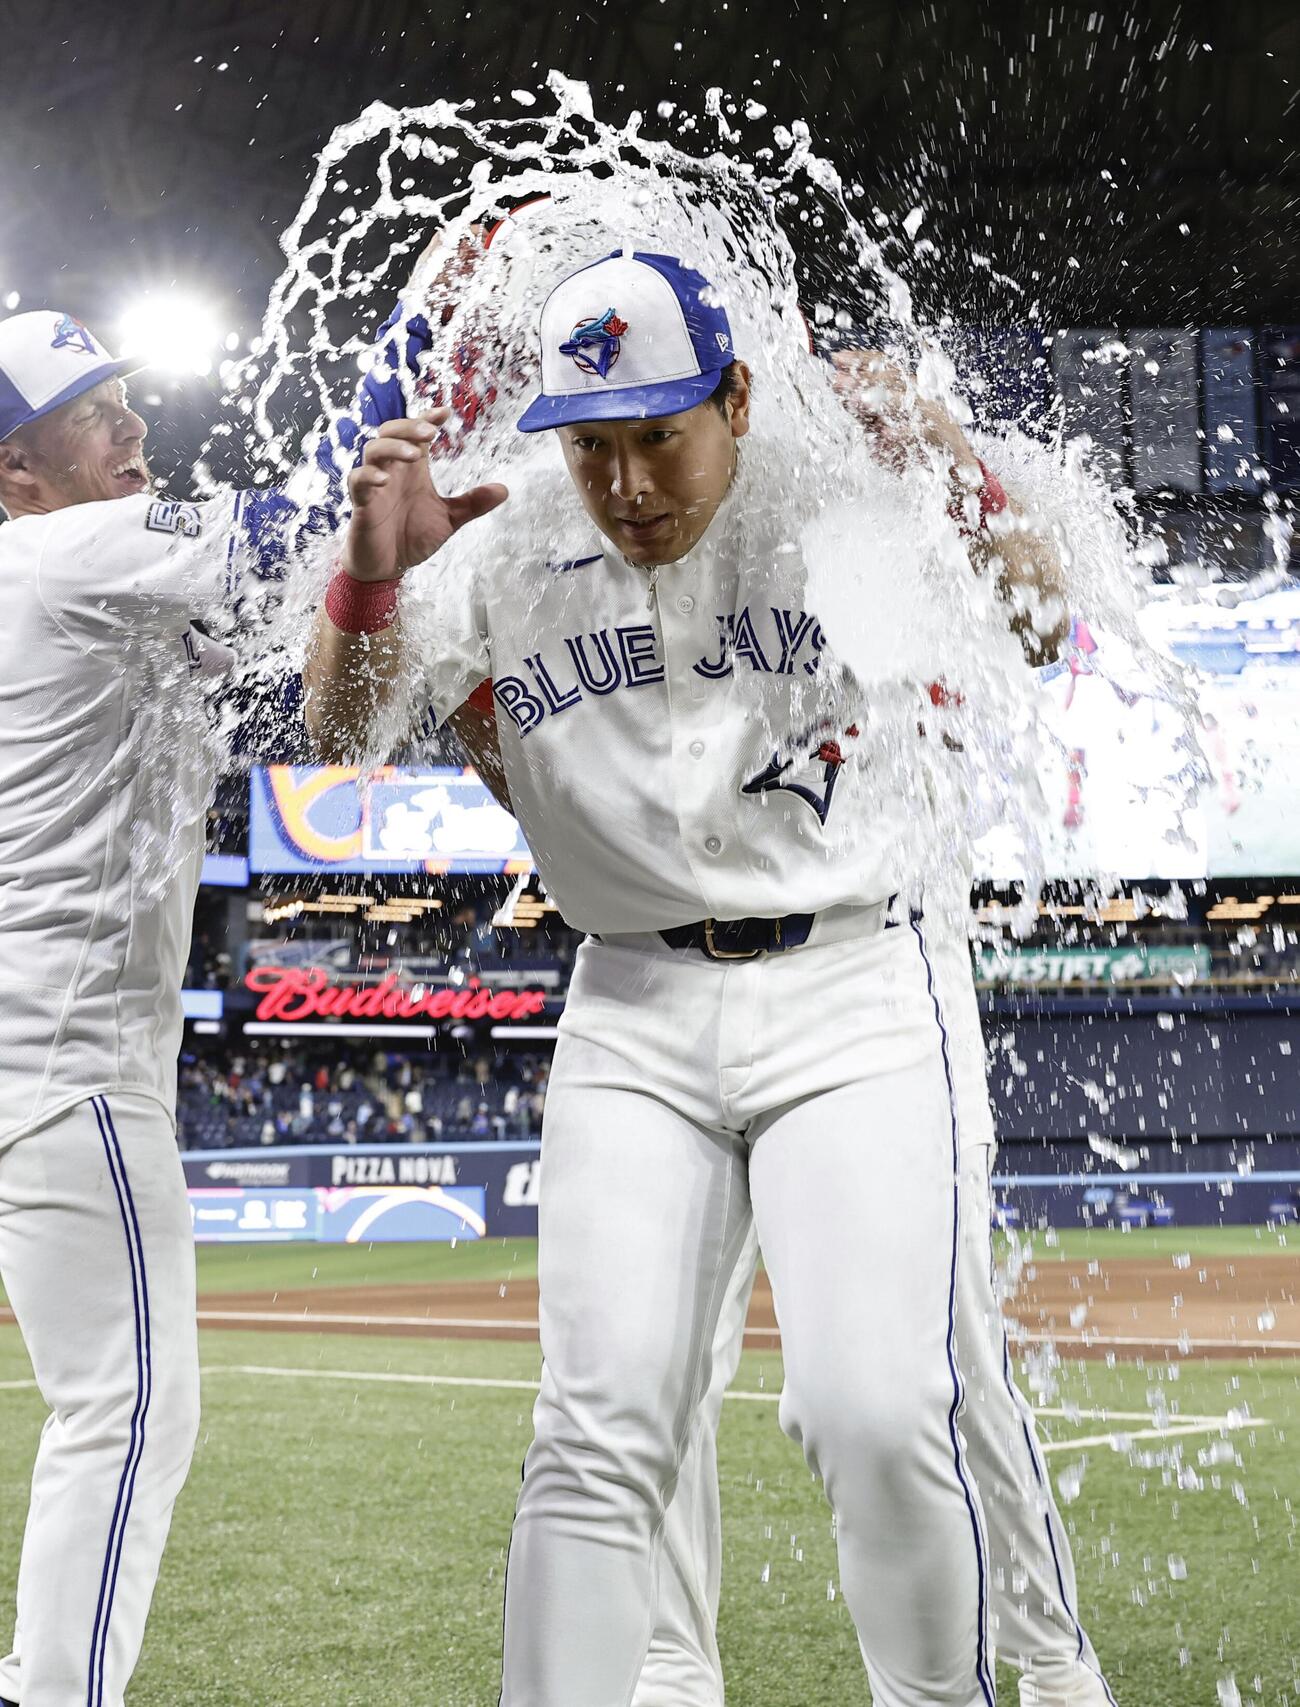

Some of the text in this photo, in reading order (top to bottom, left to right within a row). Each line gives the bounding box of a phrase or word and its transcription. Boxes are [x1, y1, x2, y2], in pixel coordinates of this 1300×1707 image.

[492, 624, 665, 739] BLUE
[979, 953, 1110, 983] WESTJET
[244, 965, 546, 1021] Budweiser
[332, 1154, 457, 1186] PIZZA NOVA
